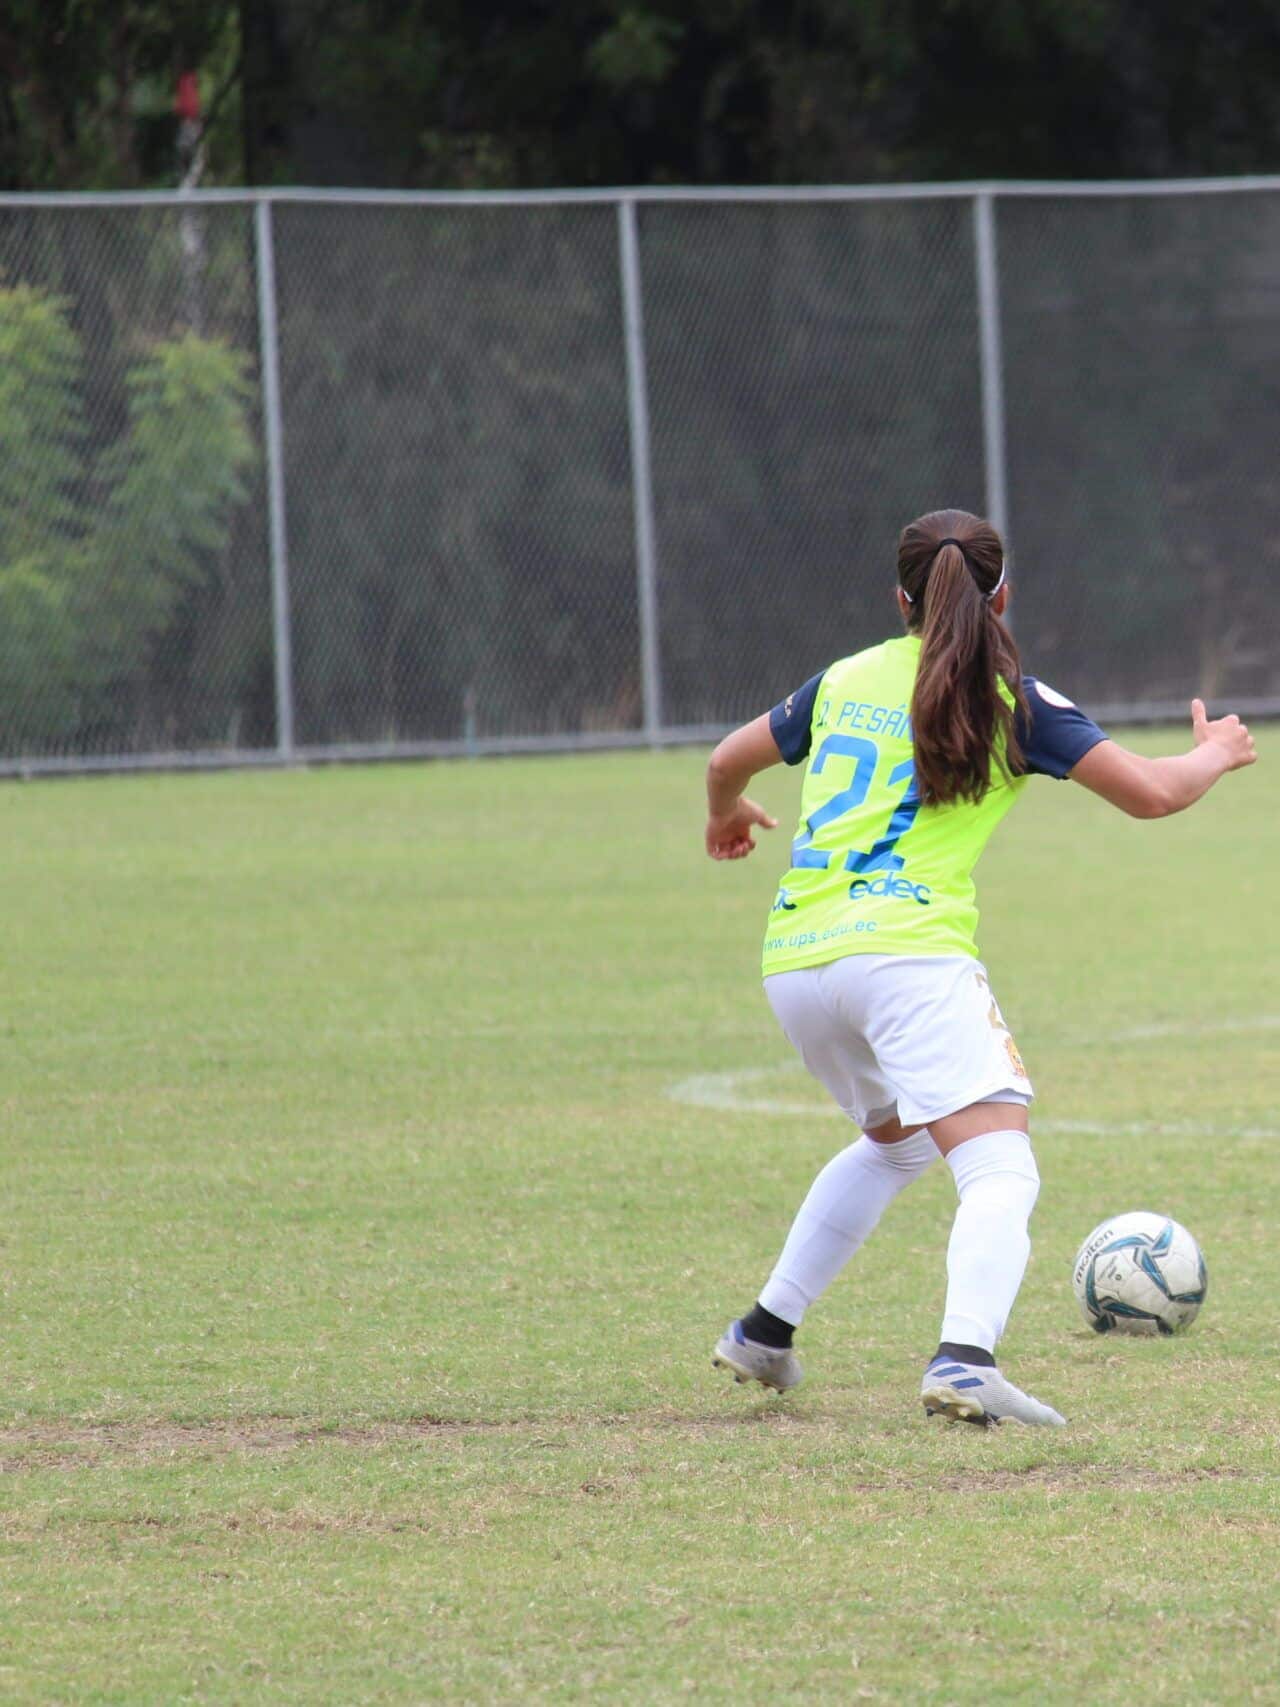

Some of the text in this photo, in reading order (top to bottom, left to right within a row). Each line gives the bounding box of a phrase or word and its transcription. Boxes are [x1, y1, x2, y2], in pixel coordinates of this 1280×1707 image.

[790, 733, 923, 875] 21
[848, 871, 932, 905] edec
[1075, 1229, 1115, 1285] molten
